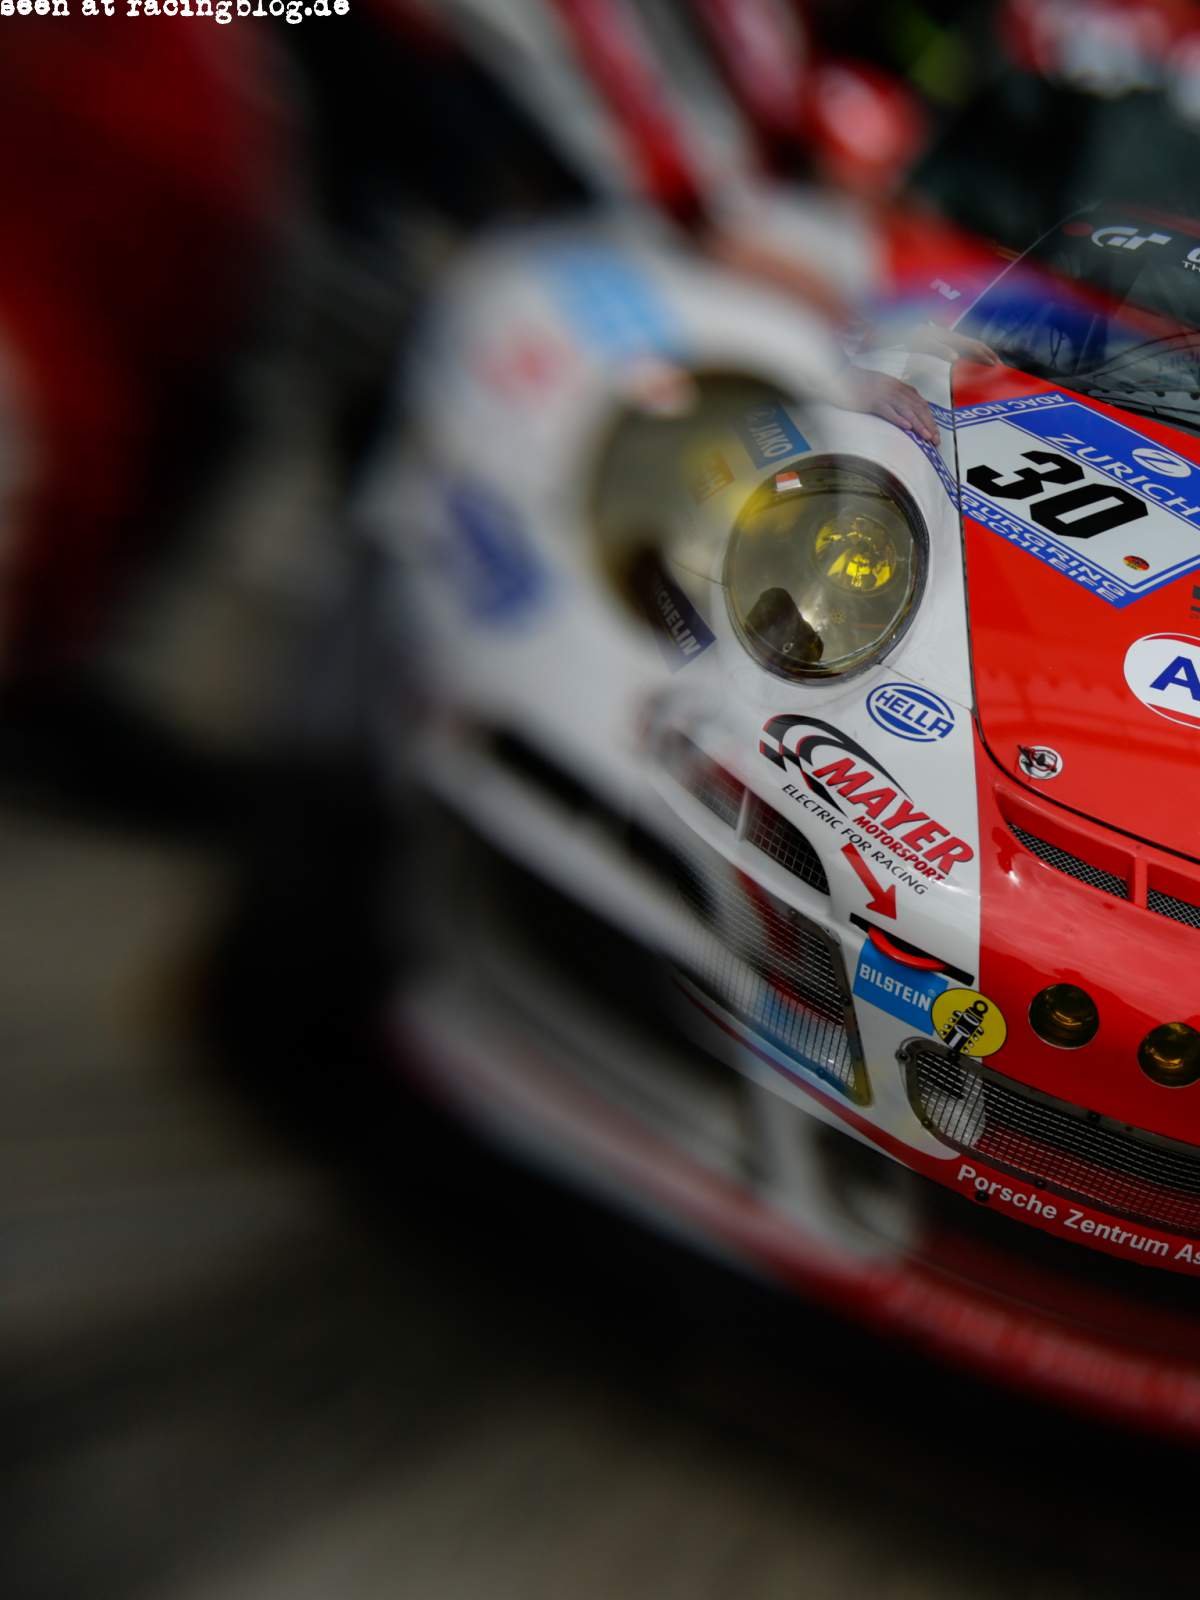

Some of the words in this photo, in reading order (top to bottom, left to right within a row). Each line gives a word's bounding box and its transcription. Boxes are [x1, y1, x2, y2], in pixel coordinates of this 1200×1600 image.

[1008, 394, 1066, 411] ADAC
[749, 423, 793, 458] JAKO
[967, 451, 1149, 539] 30
[655, 582, 701, 656] CHELIN
[875, 690, 955, 739] HELLA
[782, 784, 844, 830] ELECTRIC
[841, 828, 873, 852] FOR
[871, 850, 929, 896] RACING
[812, 757, 975, 874] MAYER
[853, 815, 947, 881] MOTORSPORT
[859, 963, 932, 1012] BILSTEIN
[957, 1164, 1057, 1220] Porsche
[1064, 1208, 1169, 1257] Zentrum
